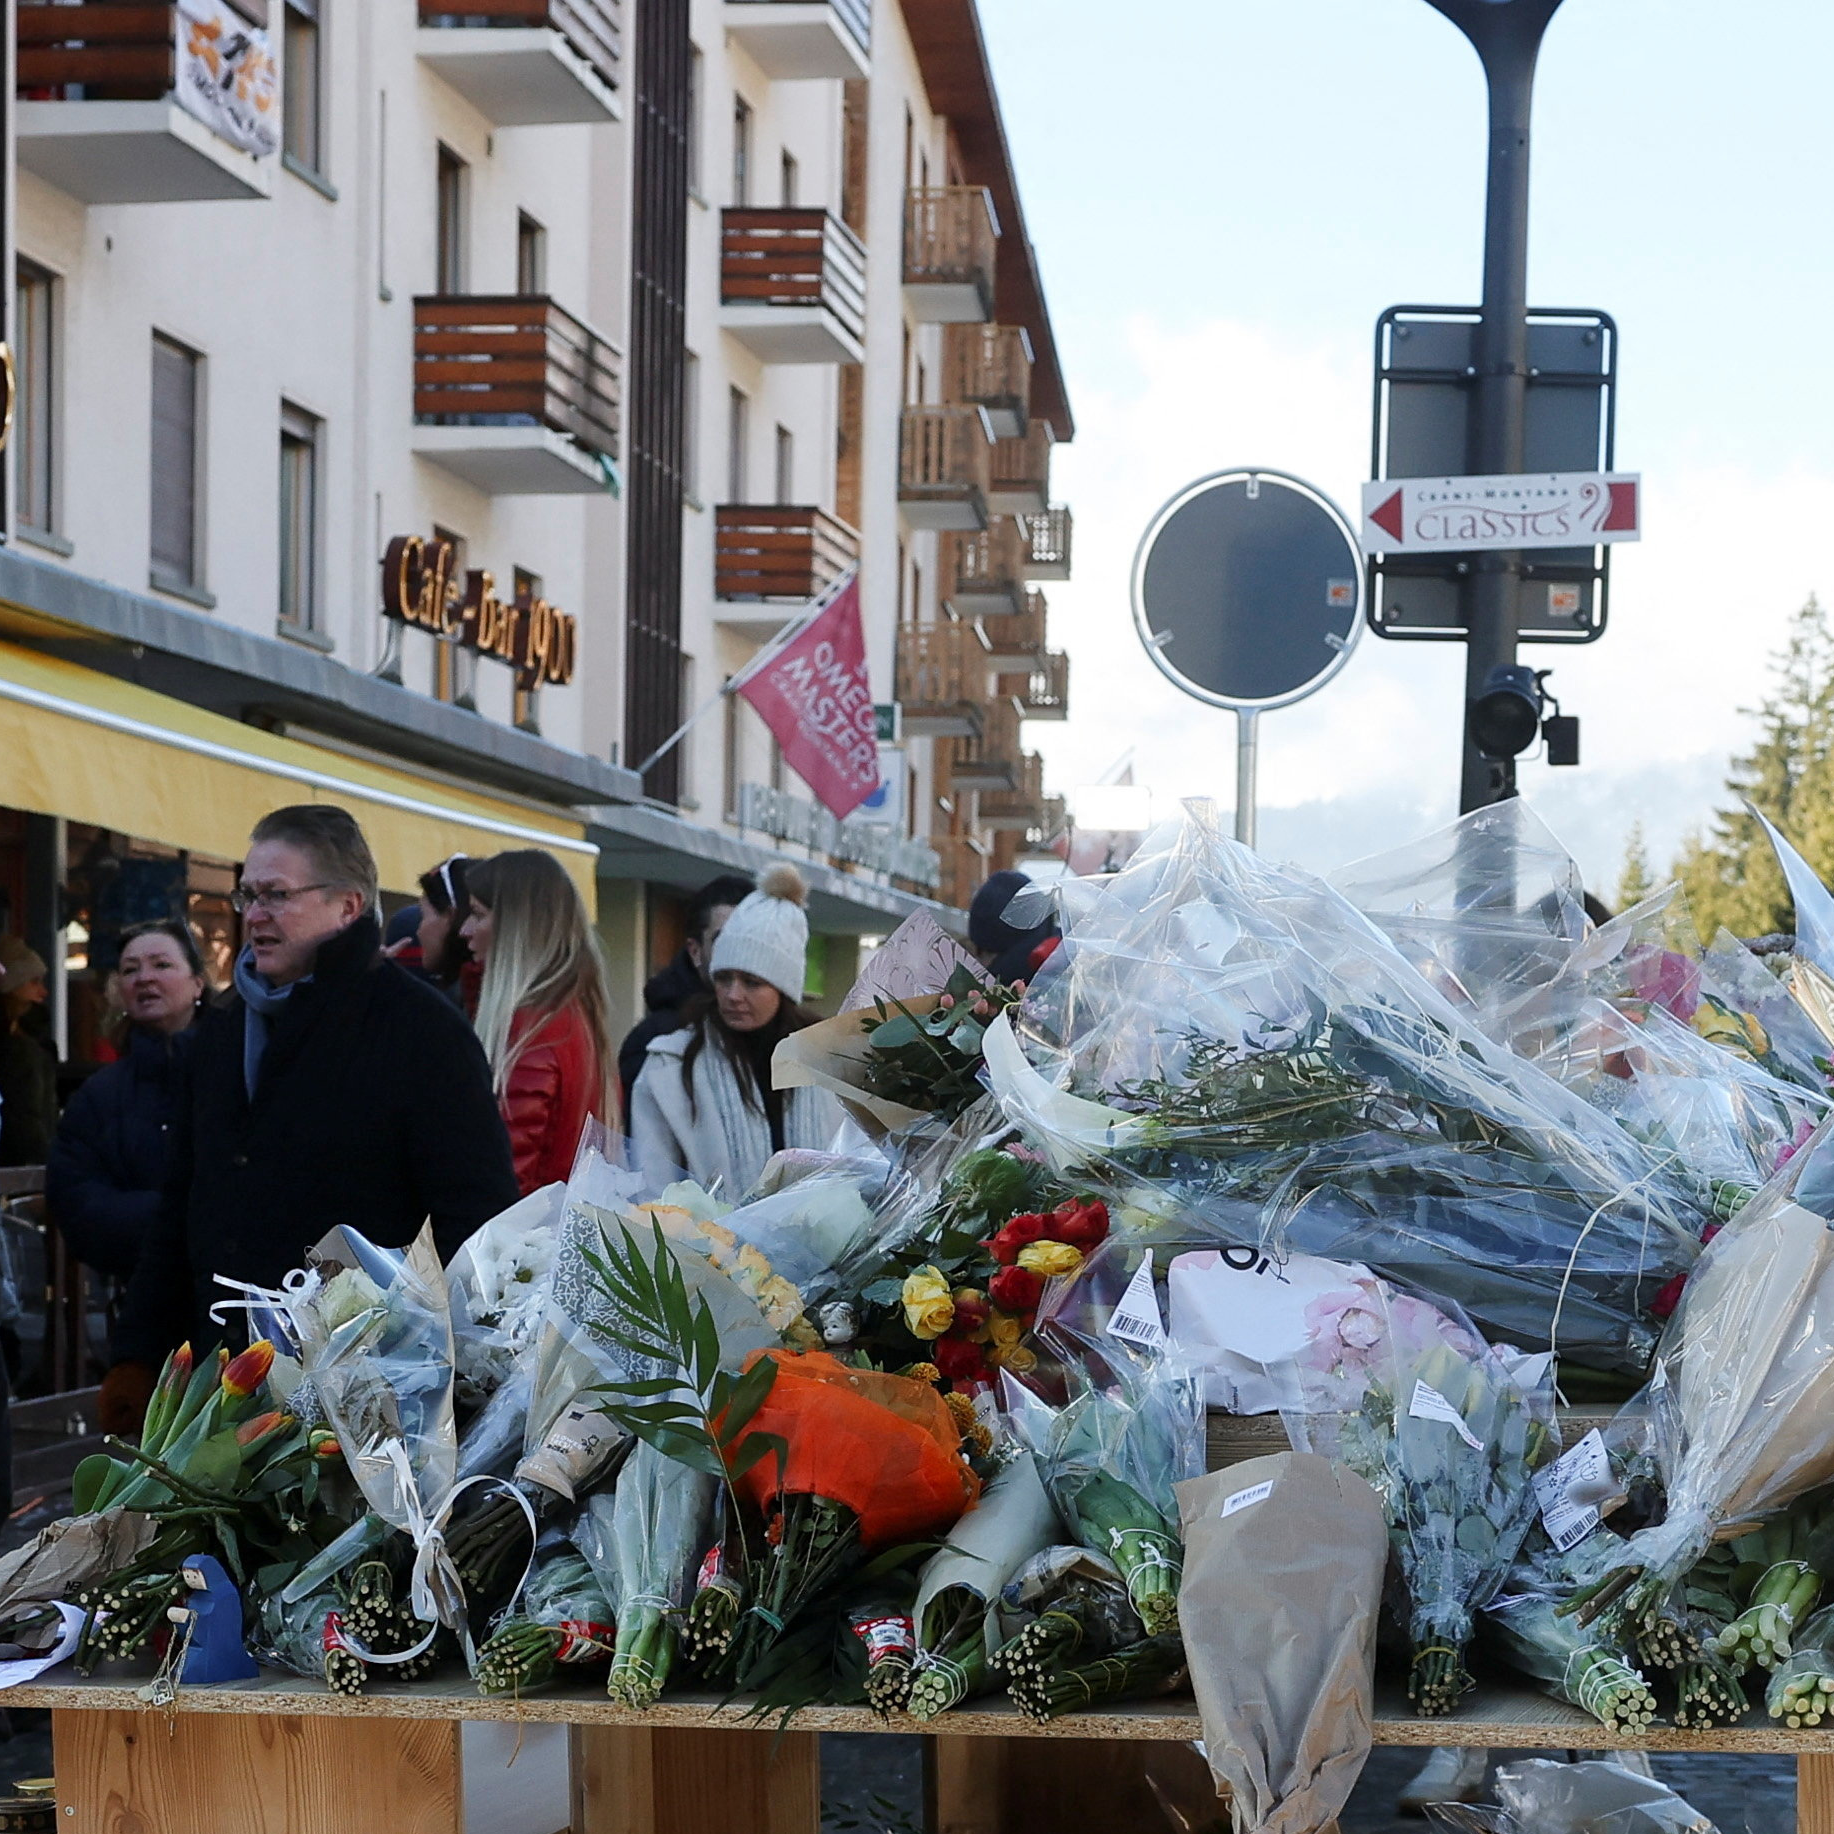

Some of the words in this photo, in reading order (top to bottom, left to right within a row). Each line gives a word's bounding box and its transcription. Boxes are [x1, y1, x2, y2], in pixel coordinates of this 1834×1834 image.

[525, 598, 577, 692] 1900
[813, 640, 878, 740] OMEG
[781, 655, 879, 783] MASTERS
